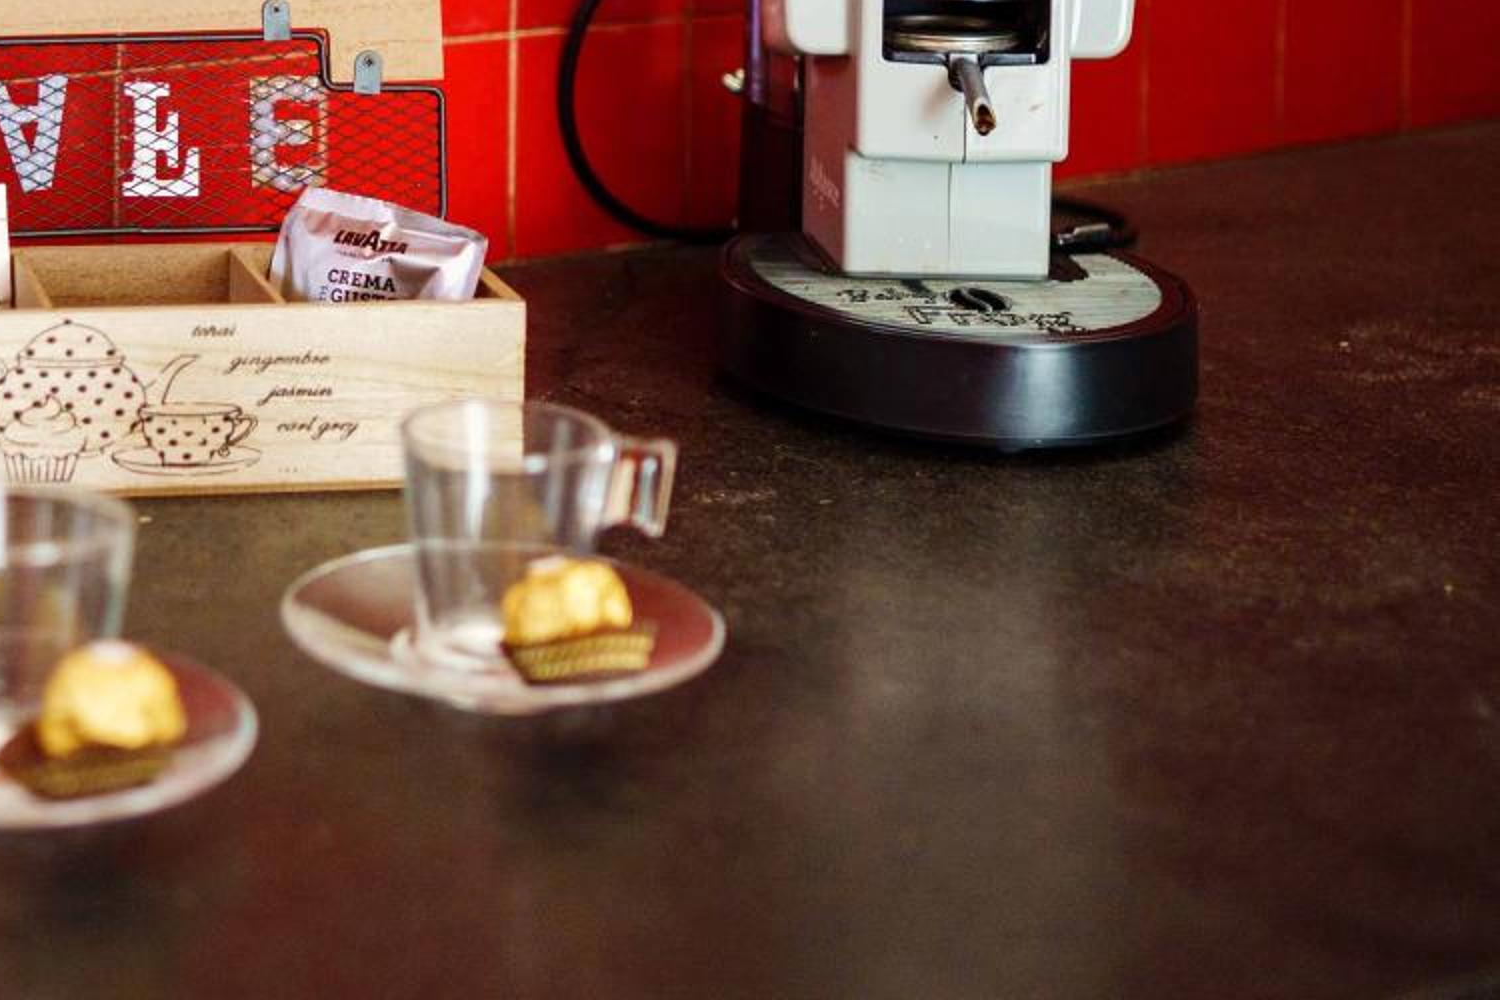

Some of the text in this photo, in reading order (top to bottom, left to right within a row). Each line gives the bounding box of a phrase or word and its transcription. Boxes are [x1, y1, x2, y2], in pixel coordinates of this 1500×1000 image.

[332, 228, 409, 255] LAVAZZA
[327, 268, 396, 293] CREMA
[256, 382, 333, 407] jasmin
[276, 414, 358, 440] earl grey
